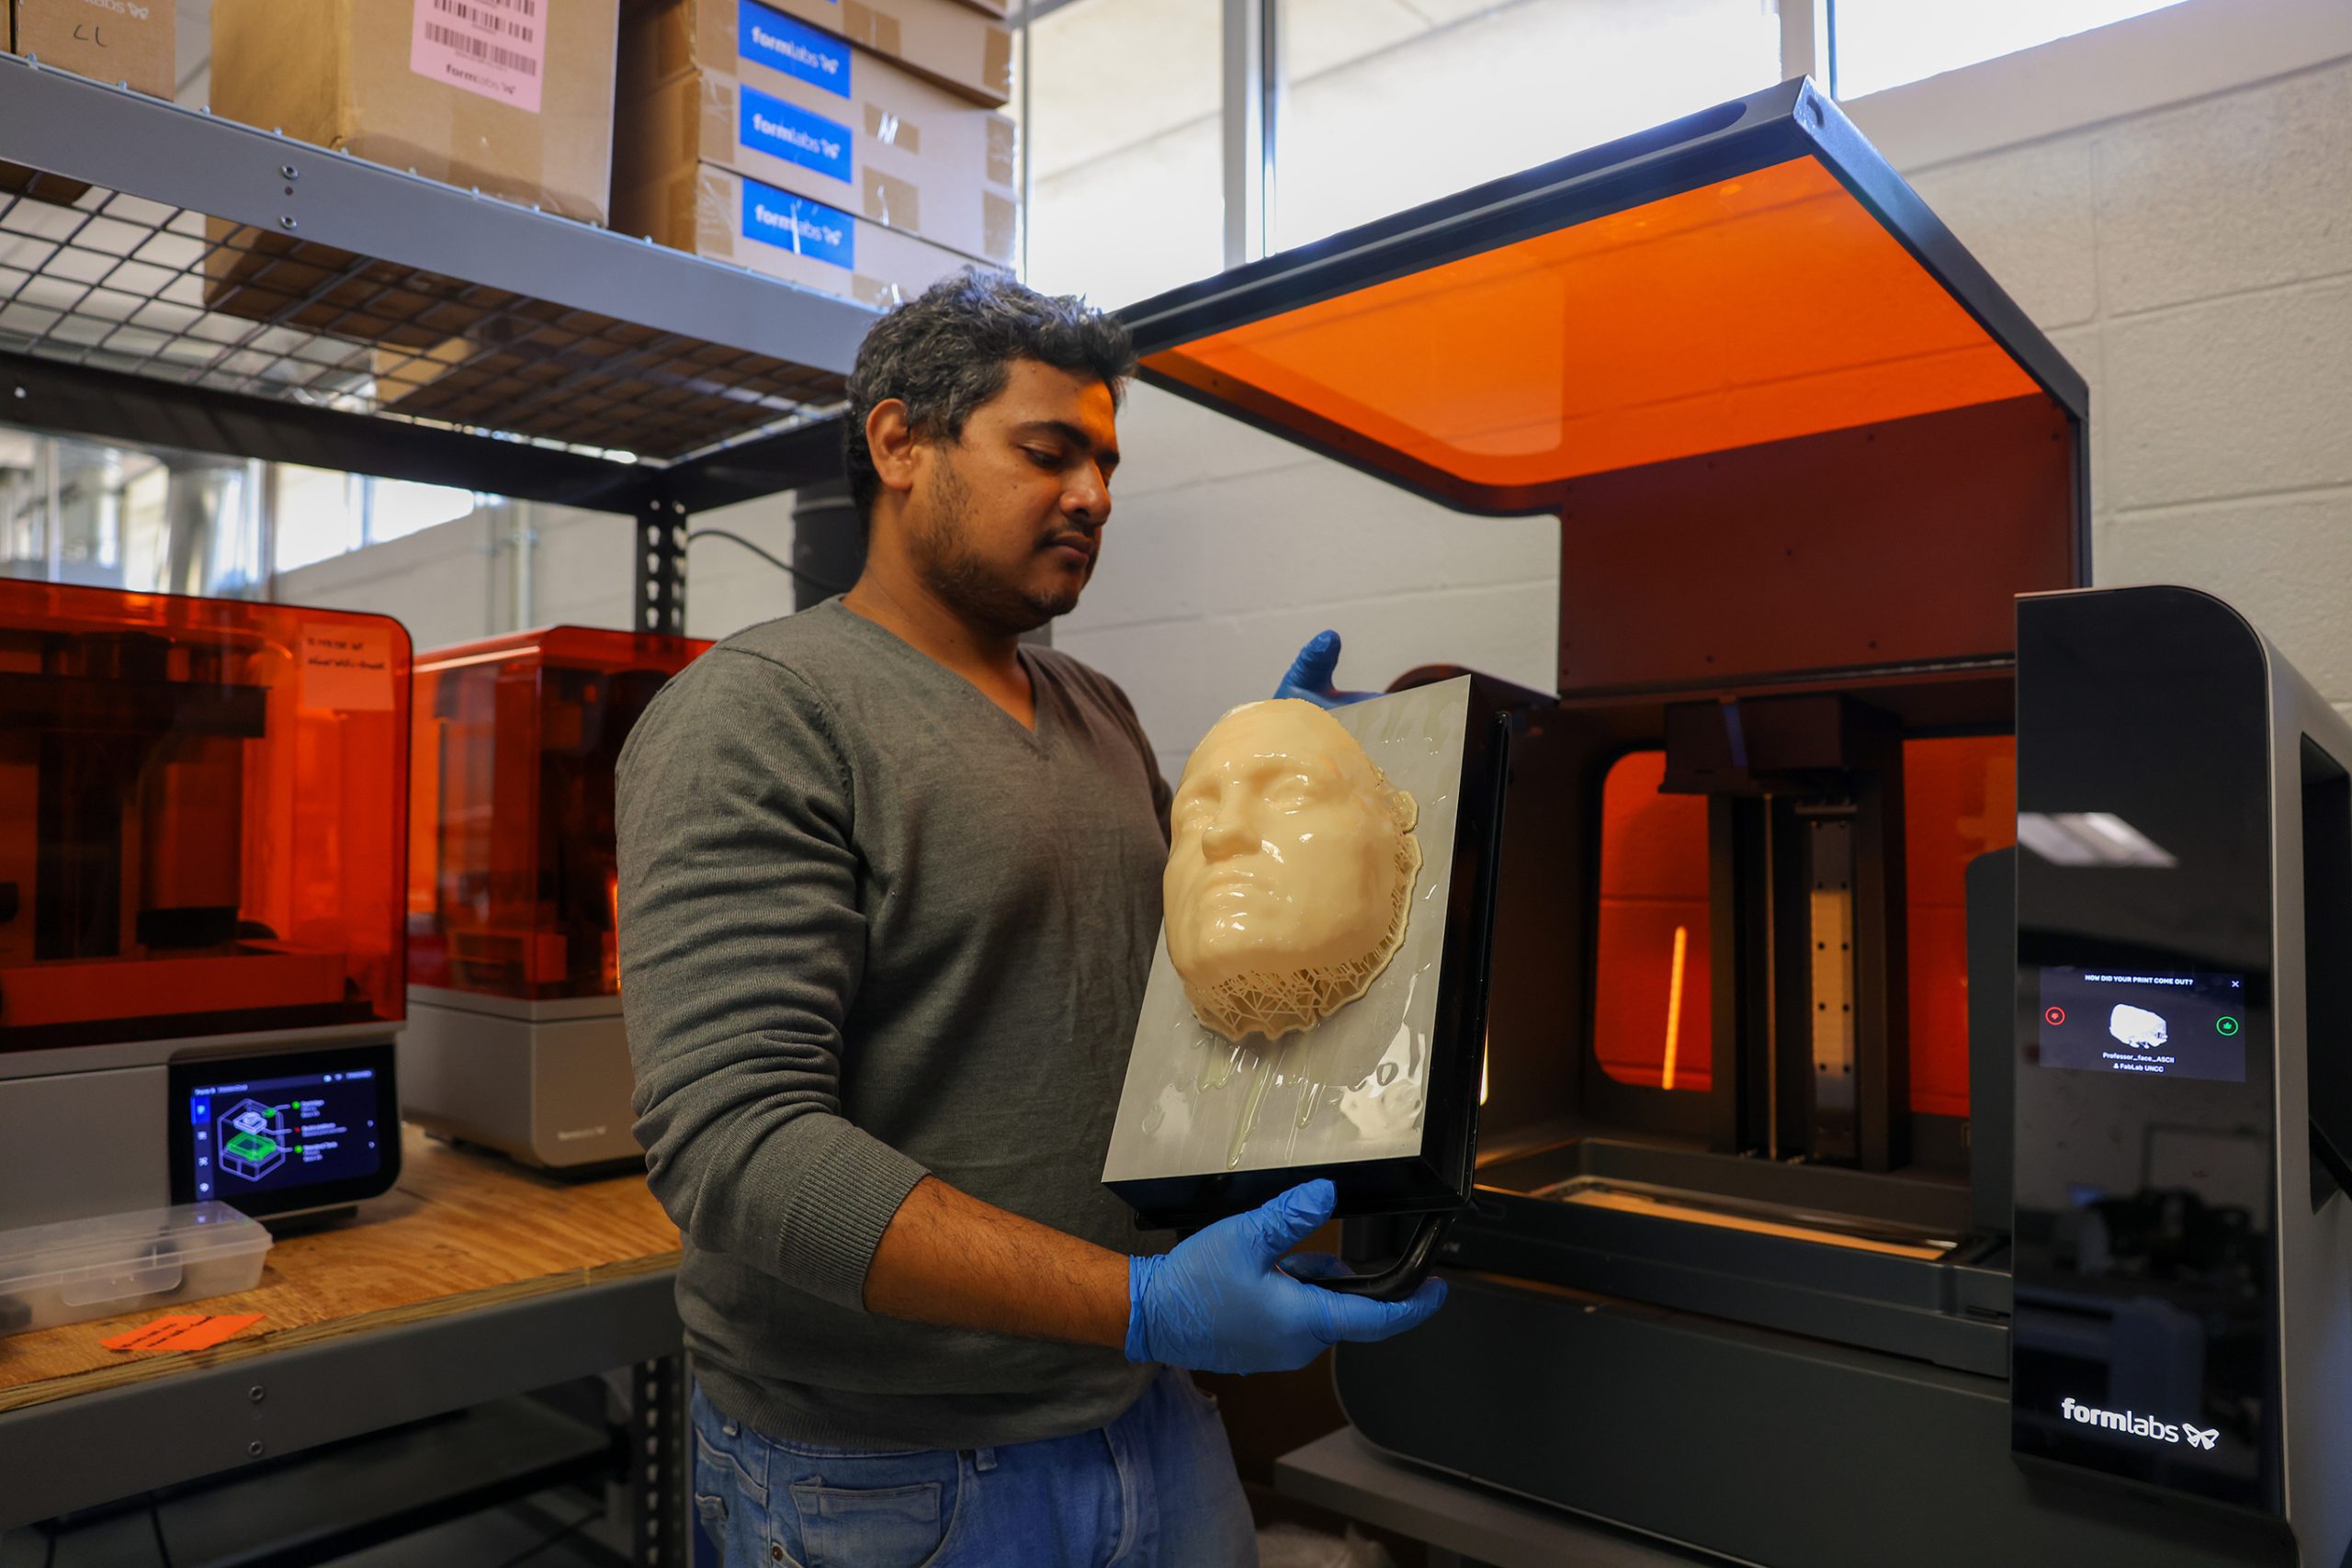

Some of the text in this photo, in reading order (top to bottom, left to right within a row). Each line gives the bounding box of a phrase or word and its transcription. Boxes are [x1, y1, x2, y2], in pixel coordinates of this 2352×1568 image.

[752, 26, 820, 69] formlabs
[752, 112, 820, 154] formlabs
[2120, 1063, 2165, 1073] FabLab UNCC
[2062, 1397, 2179, 1443] formlabs
